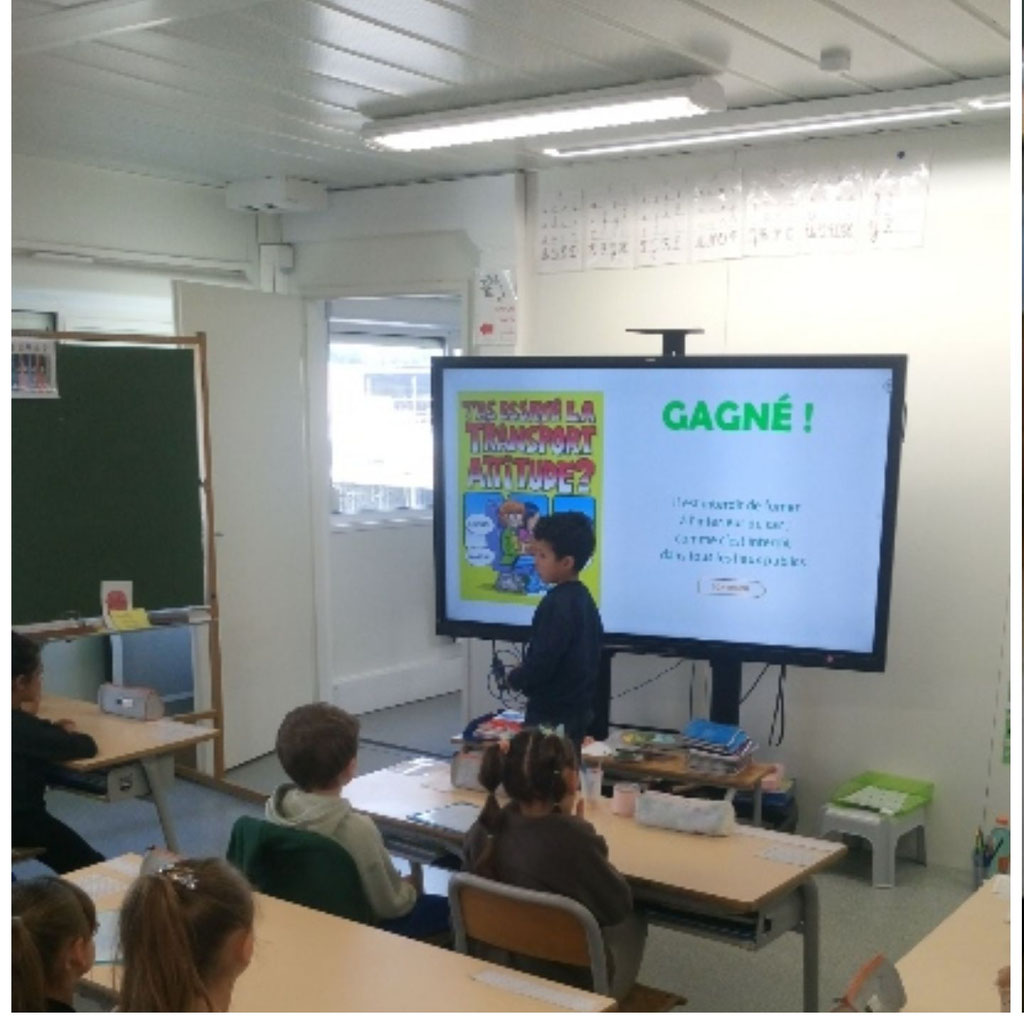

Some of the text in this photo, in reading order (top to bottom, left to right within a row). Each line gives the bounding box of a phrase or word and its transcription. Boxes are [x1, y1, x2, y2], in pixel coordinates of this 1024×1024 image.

[566, 400, 597, 423] LA
[662, 392, 814, 434] GAGNÉ !
[465, 422, 597, 455] TRANSPORT
